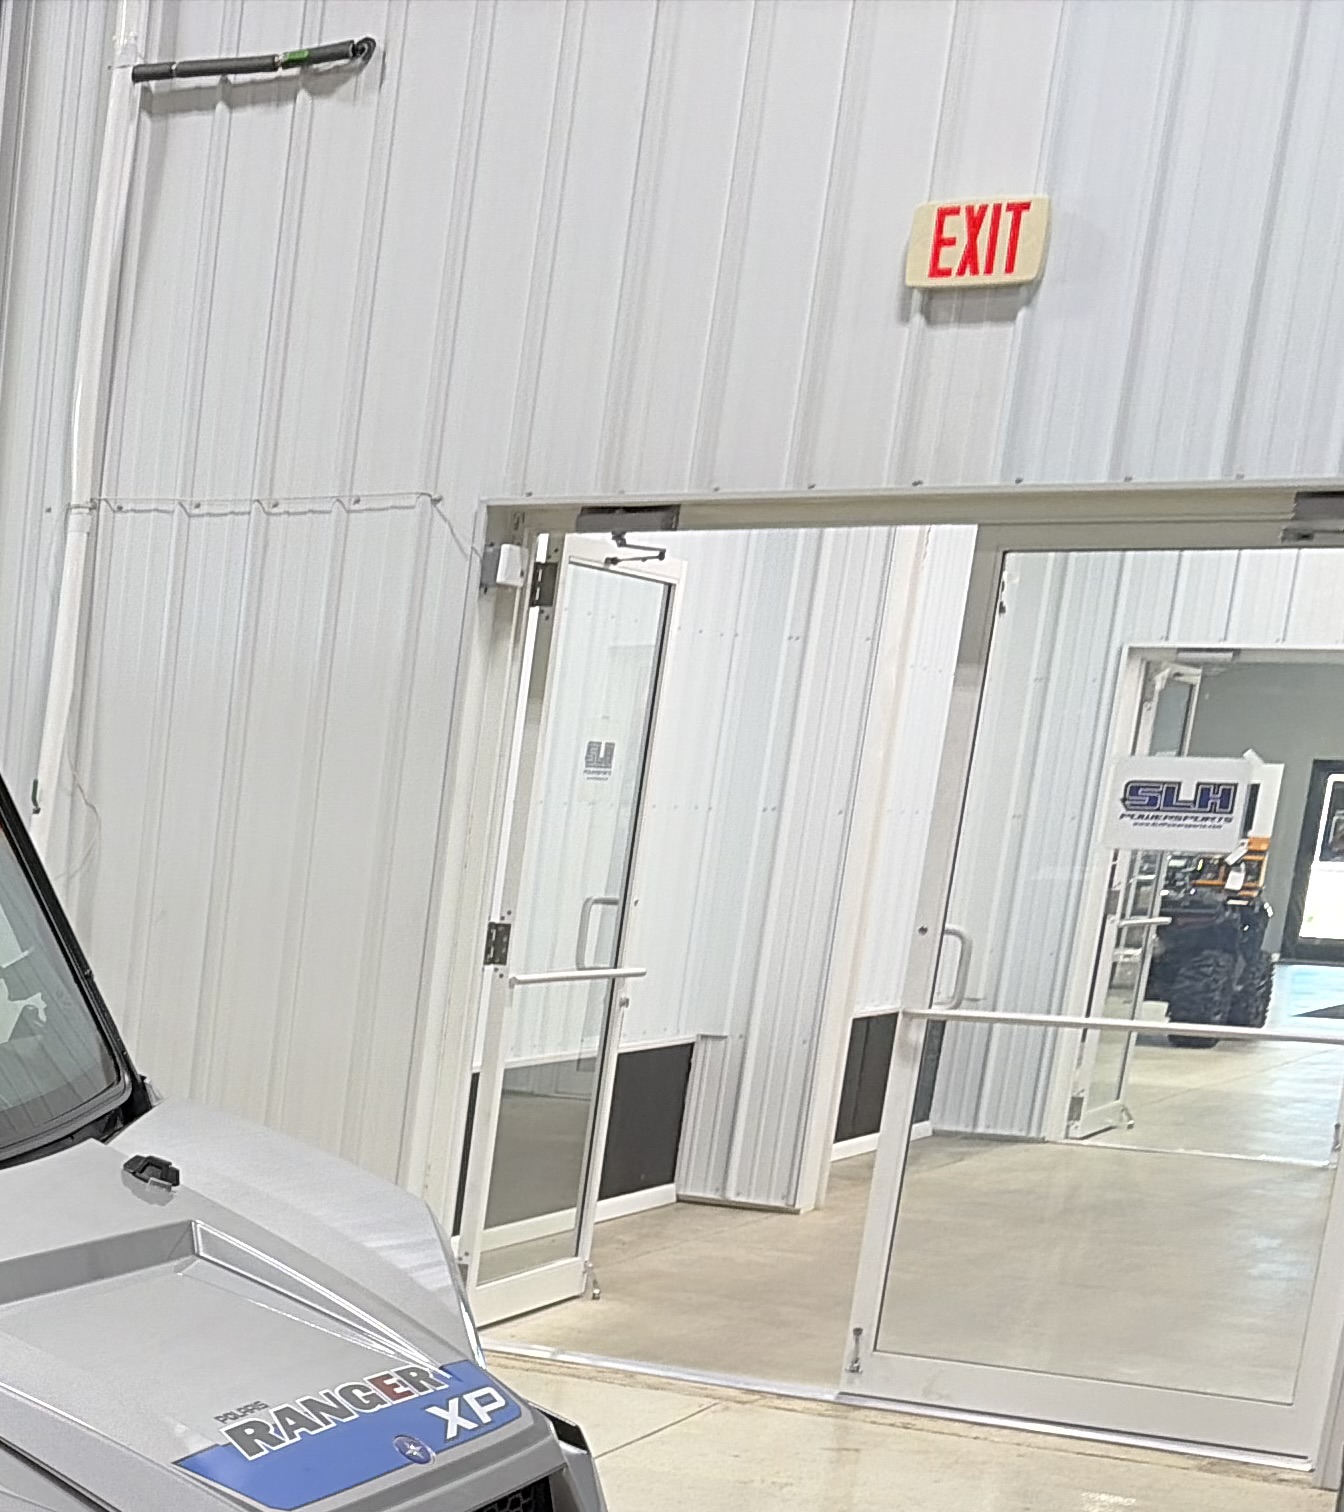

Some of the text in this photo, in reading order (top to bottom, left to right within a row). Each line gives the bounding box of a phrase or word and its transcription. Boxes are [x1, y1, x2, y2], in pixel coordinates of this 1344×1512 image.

[927, 201, 1032, 279] EXIT
[1120, 779, 1239, 815] SLH
[213, 1400, 270, 1425] POLARIS
[220, 1364, 508, 1462] RANGER XP
